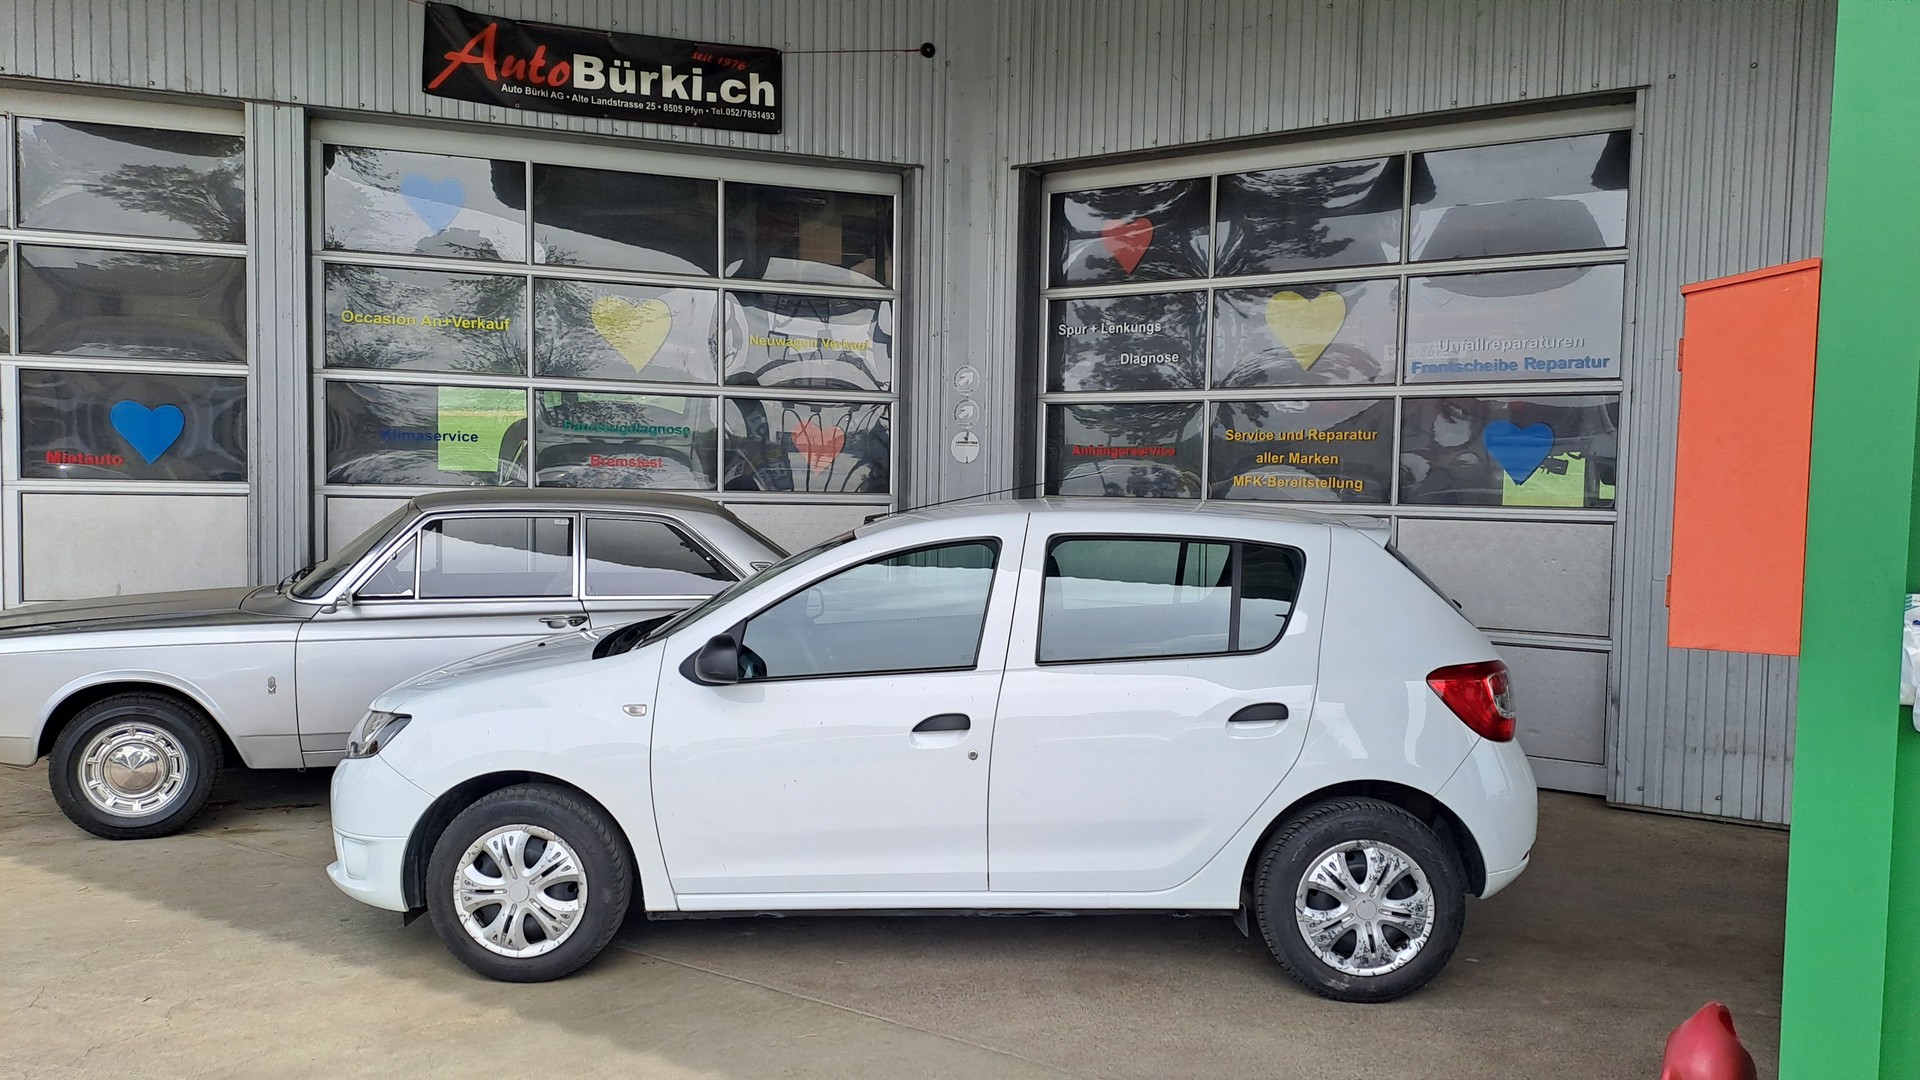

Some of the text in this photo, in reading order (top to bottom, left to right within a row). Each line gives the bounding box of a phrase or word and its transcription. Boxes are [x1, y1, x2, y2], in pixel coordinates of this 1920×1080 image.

[691, 51, 748, 71] seit 1976
[501, 83, 523, 95] Auto
[525, 86, 549, 98] Bürki
[550, 91, 565, 101] AG
[571, 93, 589, 103] Alte
[591, 95, 644, 110] Landstrasse
[645, 102, 656, 111] 25
[663, 103, 683, 114] 8505
[685, 105, 704, 117] Pfyn
[342, 310, 511, 331] Occasion An+Verkauf
[1058, 324, 1087, 338] Spur
[1101, 322, 1162, 335] Lenkungs
[749, 335, 870, 350] Neuwagen Verkauf
[1439, 336, 1585, 352] Unfallreparaturen
[1120, 352, 1180, 367] Diagnose
[1411, 355, 1611, 374] Frontscheibe Reparatur
[380, 427, 479, 442] Klimaservice
[1225, 429, 1378, 443] Service und Reparatur
[46, 450, 124, 466] Mietauto
[1072, 444, 1177, 459] Anhängerservice
[1256, 452, 1339, 465] aller Marken
[590, 454, 664, 468] Bremstest
[1233, 475, 1363, 492] MFK-Bereitstellung
